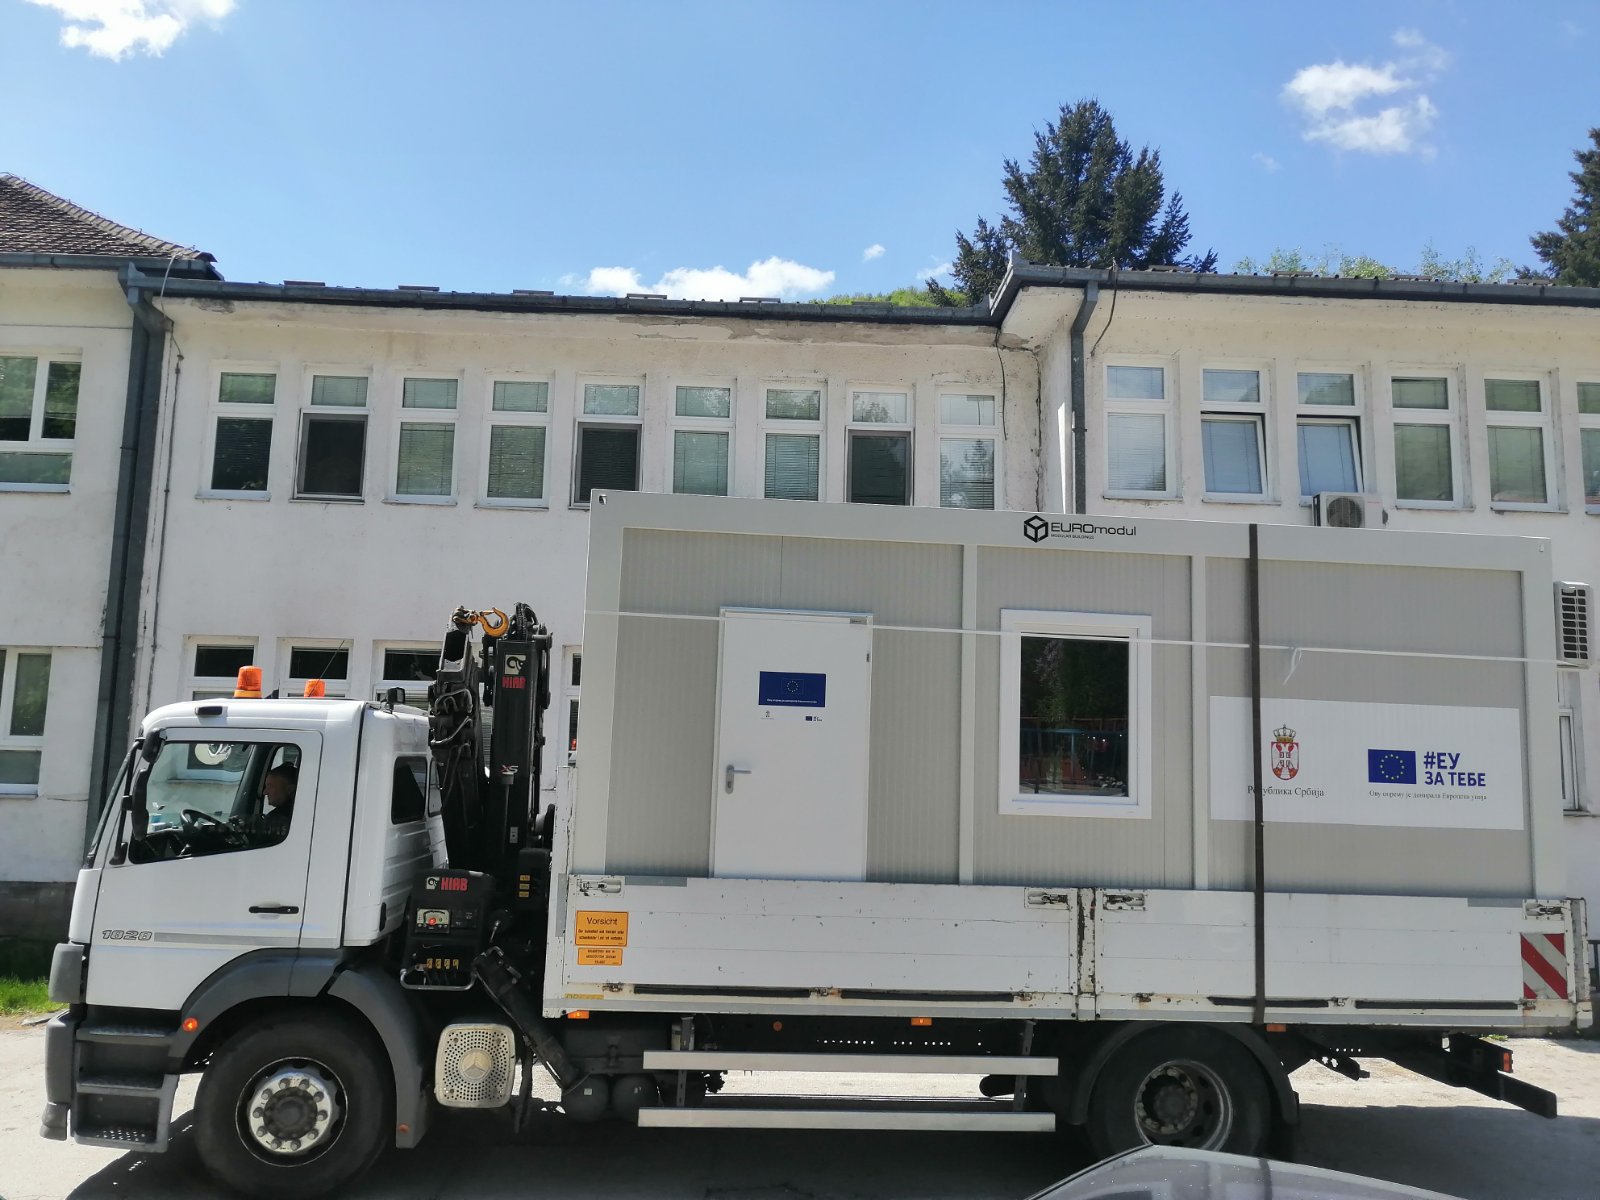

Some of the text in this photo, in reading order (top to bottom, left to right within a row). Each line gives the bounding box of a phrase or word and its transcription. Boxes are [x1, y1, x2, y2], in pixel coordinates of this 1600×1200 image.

[1051, 522, 1137, 536] EUROmodul
[502, 676, 526, 688] HIAB
[1423, 751, 1461, 770] #ЕУ
[1424, 771, 1487, 787] ЗА ТЕБЕ
[1294, 787, 1325, 799] Србија
[440, 877, 468, 891] HIAB
[586, 916, 618, 926] Vorsicht
